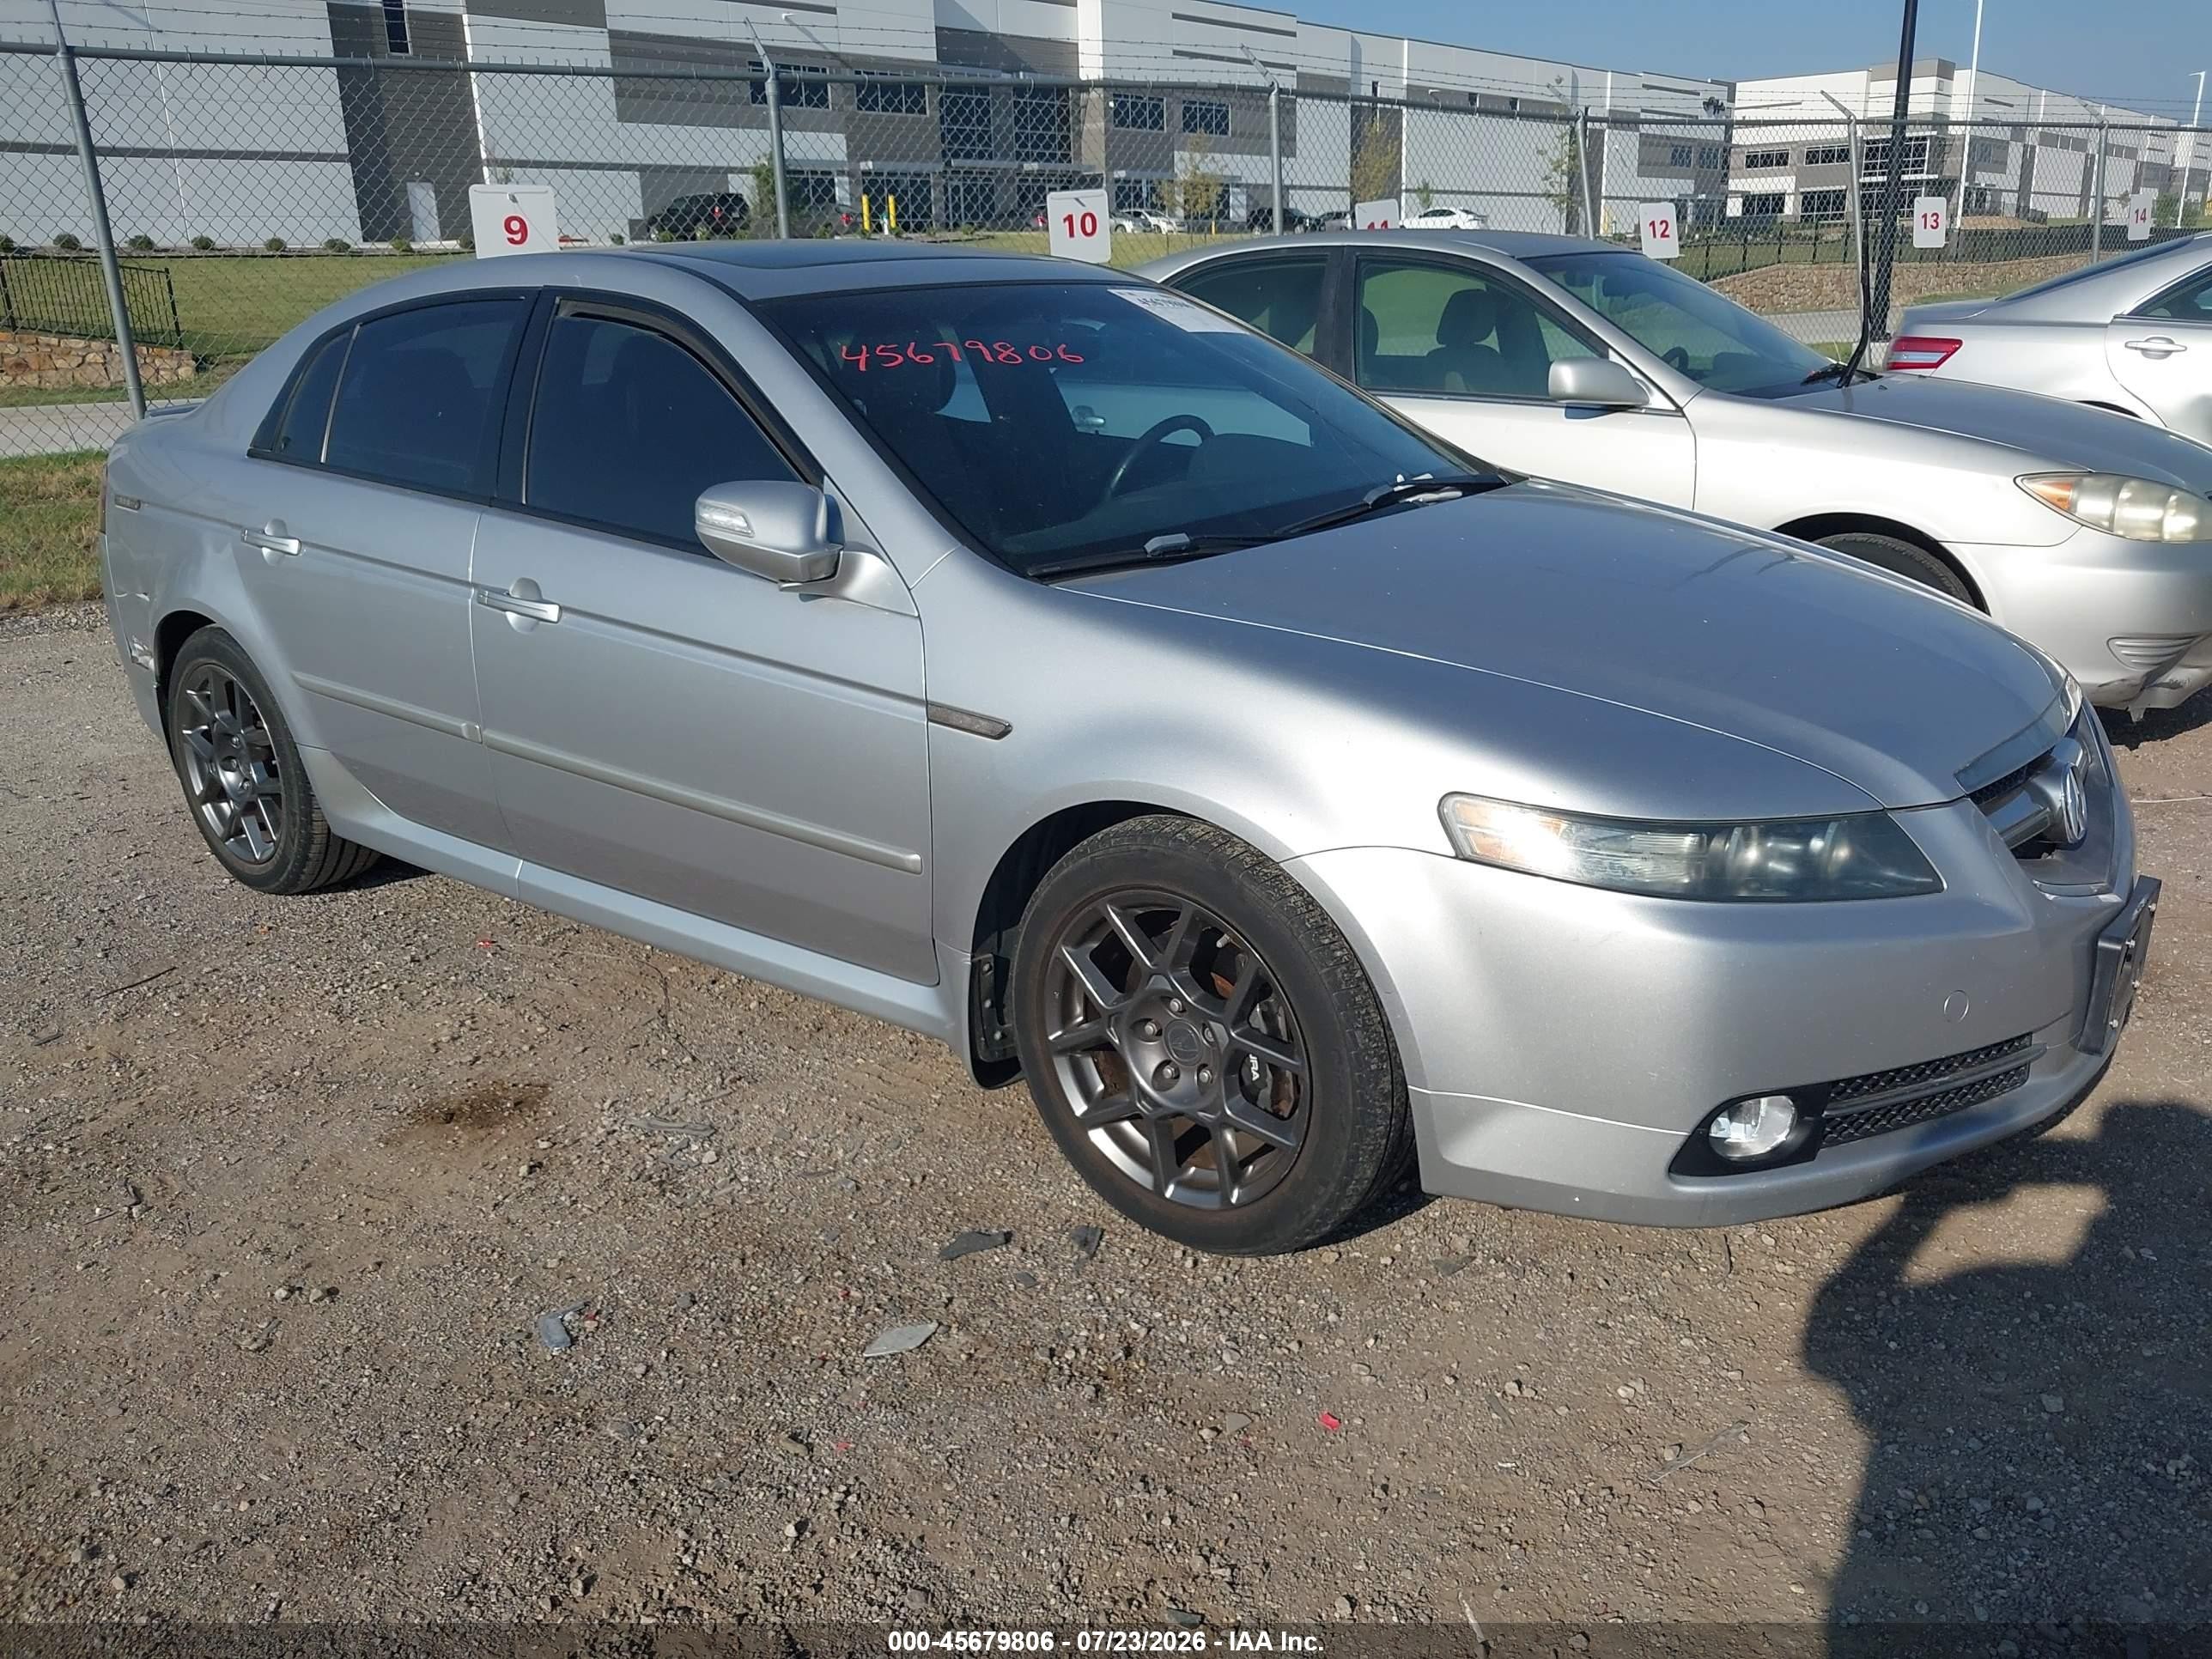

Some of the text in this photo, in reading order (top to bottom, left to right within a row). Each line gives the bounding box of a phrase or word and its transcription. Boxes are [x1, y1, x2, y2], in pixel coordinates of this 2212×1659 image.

[1063, 213, 1098, 238] 10
[1922, 212, 1940, 230] 13
[2135, 208, 2147, 223] 14
[505, 216, 527, 245] 9
[1649, 220, 1670, 239] 12
[842, 340, 1085, 372] 45679806
